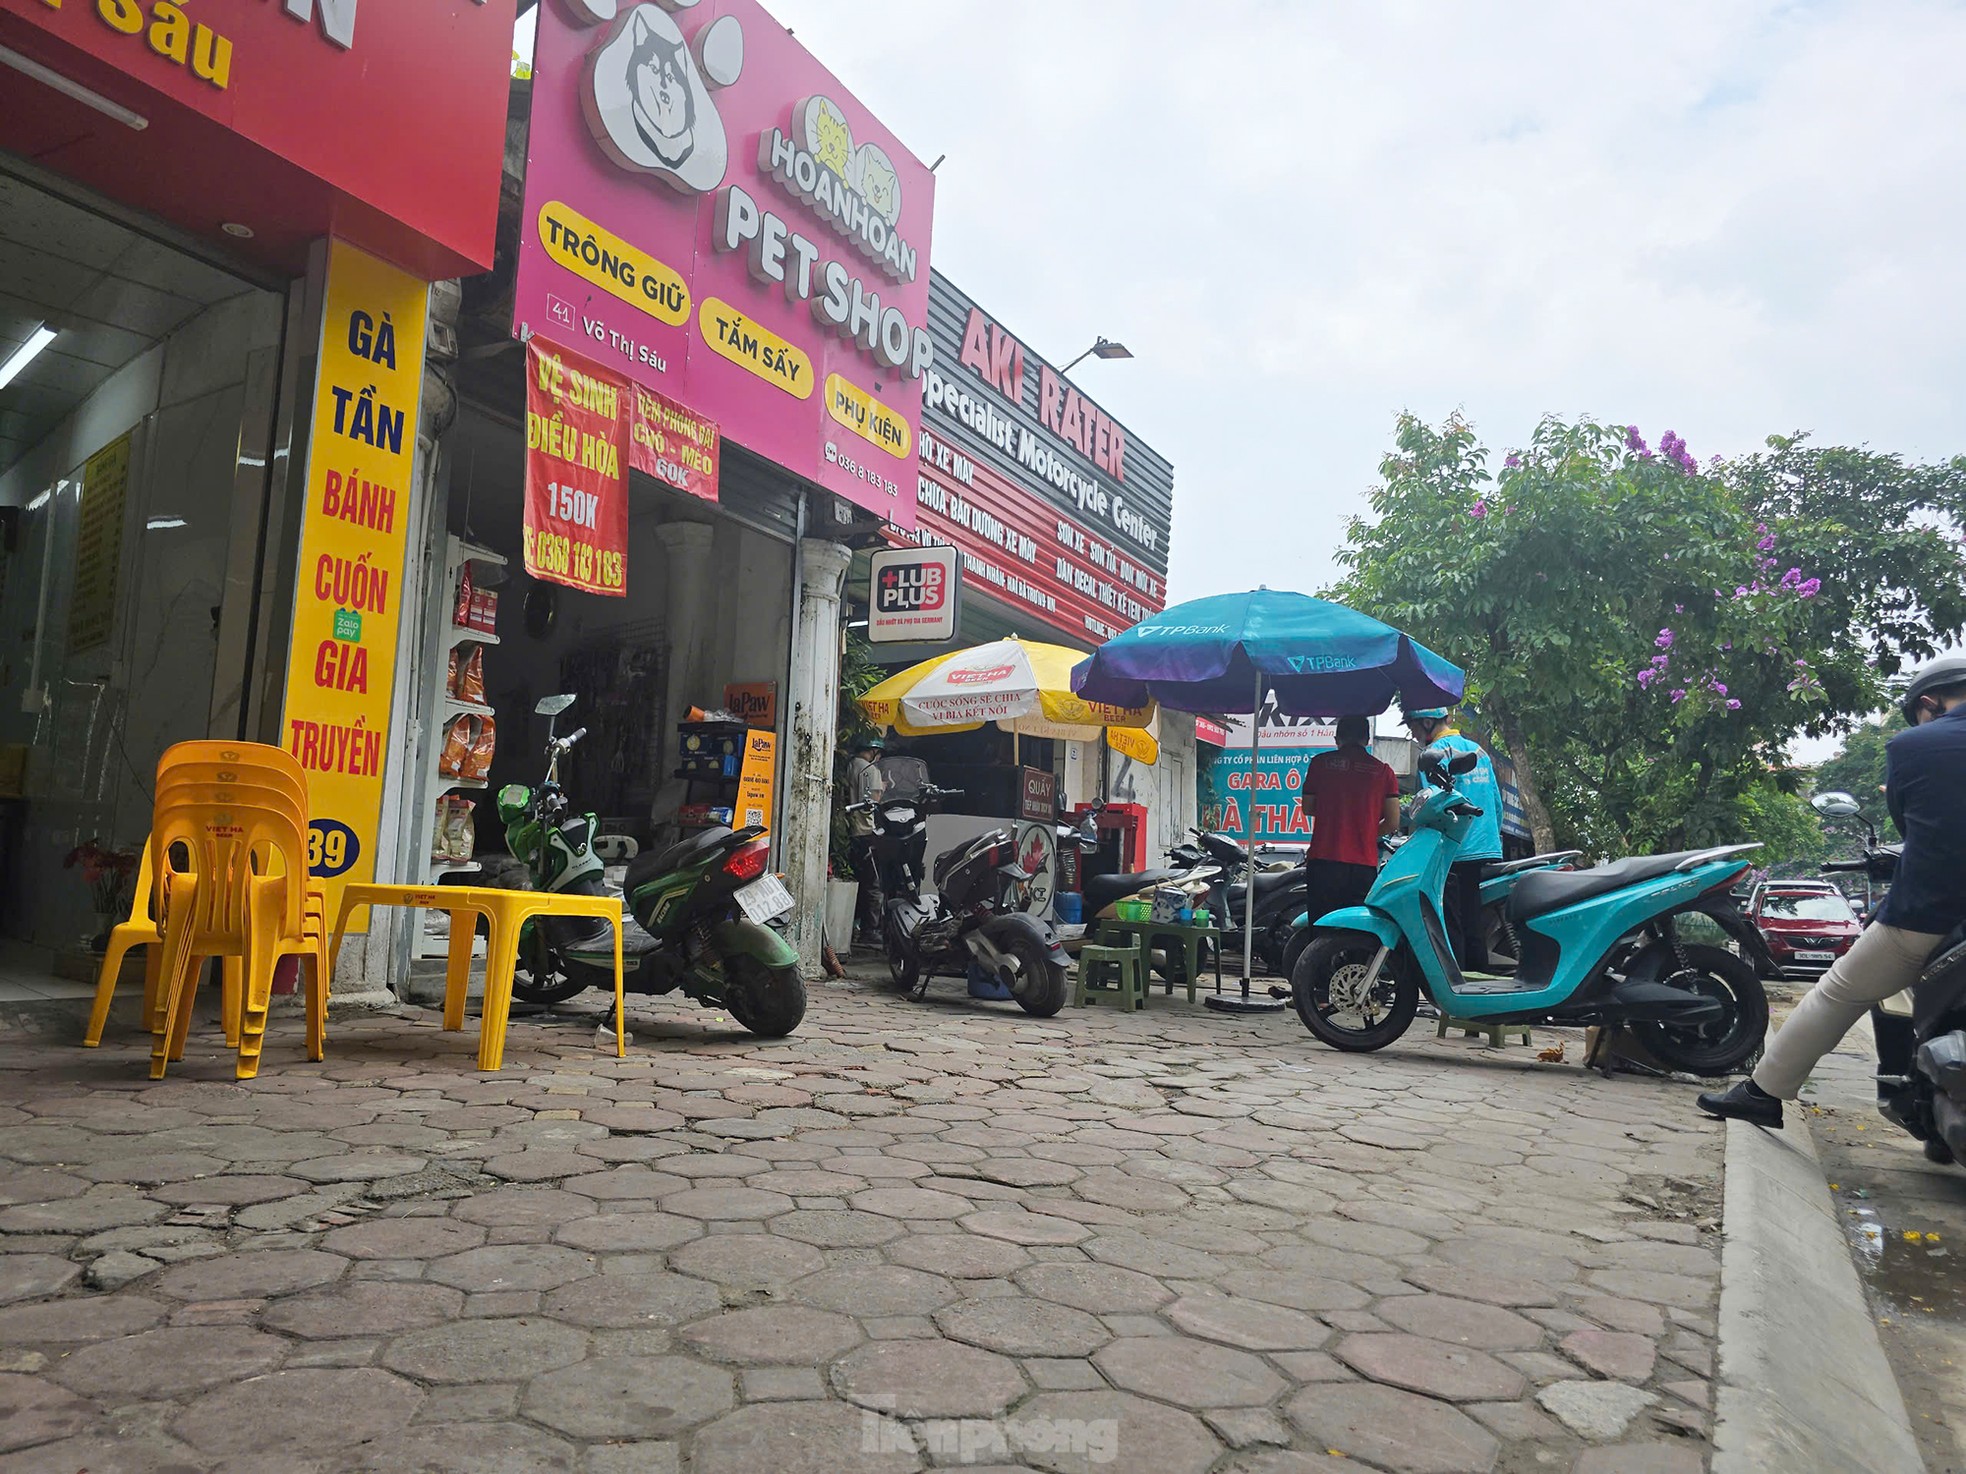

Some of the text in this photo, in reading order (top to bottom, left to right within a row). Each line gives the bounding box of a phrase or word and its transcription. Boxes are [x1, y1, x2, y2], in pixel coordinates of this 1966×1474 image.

[770, 128, 917, 282] HOANHOAN
[546, 215, 685, 313] TRÔNG GIỮ
[726, 185, 935, 380] PET SHOP
[348, 309, 396, 371] GÀ
[553, 302, 570, 324] 41
[583, 315, 667, 373] Võ Thị Sáu
[715, 318, 800, 382] TẮM SẤY
[538, 355, 618, 421] VỆ SINH
[958, 307, 1125, 484] AKI RATER
[332, 384, 404, 456] TẦN
[637, 392, 662, 424] TIÊM
[663, 408, 697, 441] PHÒNG
[835, 391, 902, 449] PHỤ KIỆN
[527, 412, 619, 481] ĐIỀU HÒA
[634, 422, 665, 454] CHÓ
[682, 444, 713, 476] MÈO
[936, 442, 949, 472] XE
[322, 467, 396, 534] BÁNH
[838, 453, 898, 496] 036 8 183 183
[1016, 428, 1107, 517] Motorcycle
[1112, 496, 1158, 551] Center
[548, 482, 599, 530] 150K
[537, 531, 569, 575] 0368
[574, 541, 594, 582] 183
[596, 549, 622, 586] 183
[1005, 526, 1018, 554] XE
[315, 552, 388, 615] CUỐN
[884, 587, 939, 608] PLUS
[337, 627, 356, 638] pay
[338, 617, 359, 630] Zalo
[1159, 624, 1230, 636] TPBank
[315, 639, 368, 694] GIA
[1307, 656, 1357, 670] TPBank
[949, 694, 977, 708] SỐNG
[995, 693, 1021, 703] CHIA
[1103, 715, 1127, 723] BEER
[291, 715, 381, 777] TRUYỀN
[1223, 757, 1233, 765] TY
[1285, 768, 1302, 791] Ô
[307, 827, 347, 869] 39
